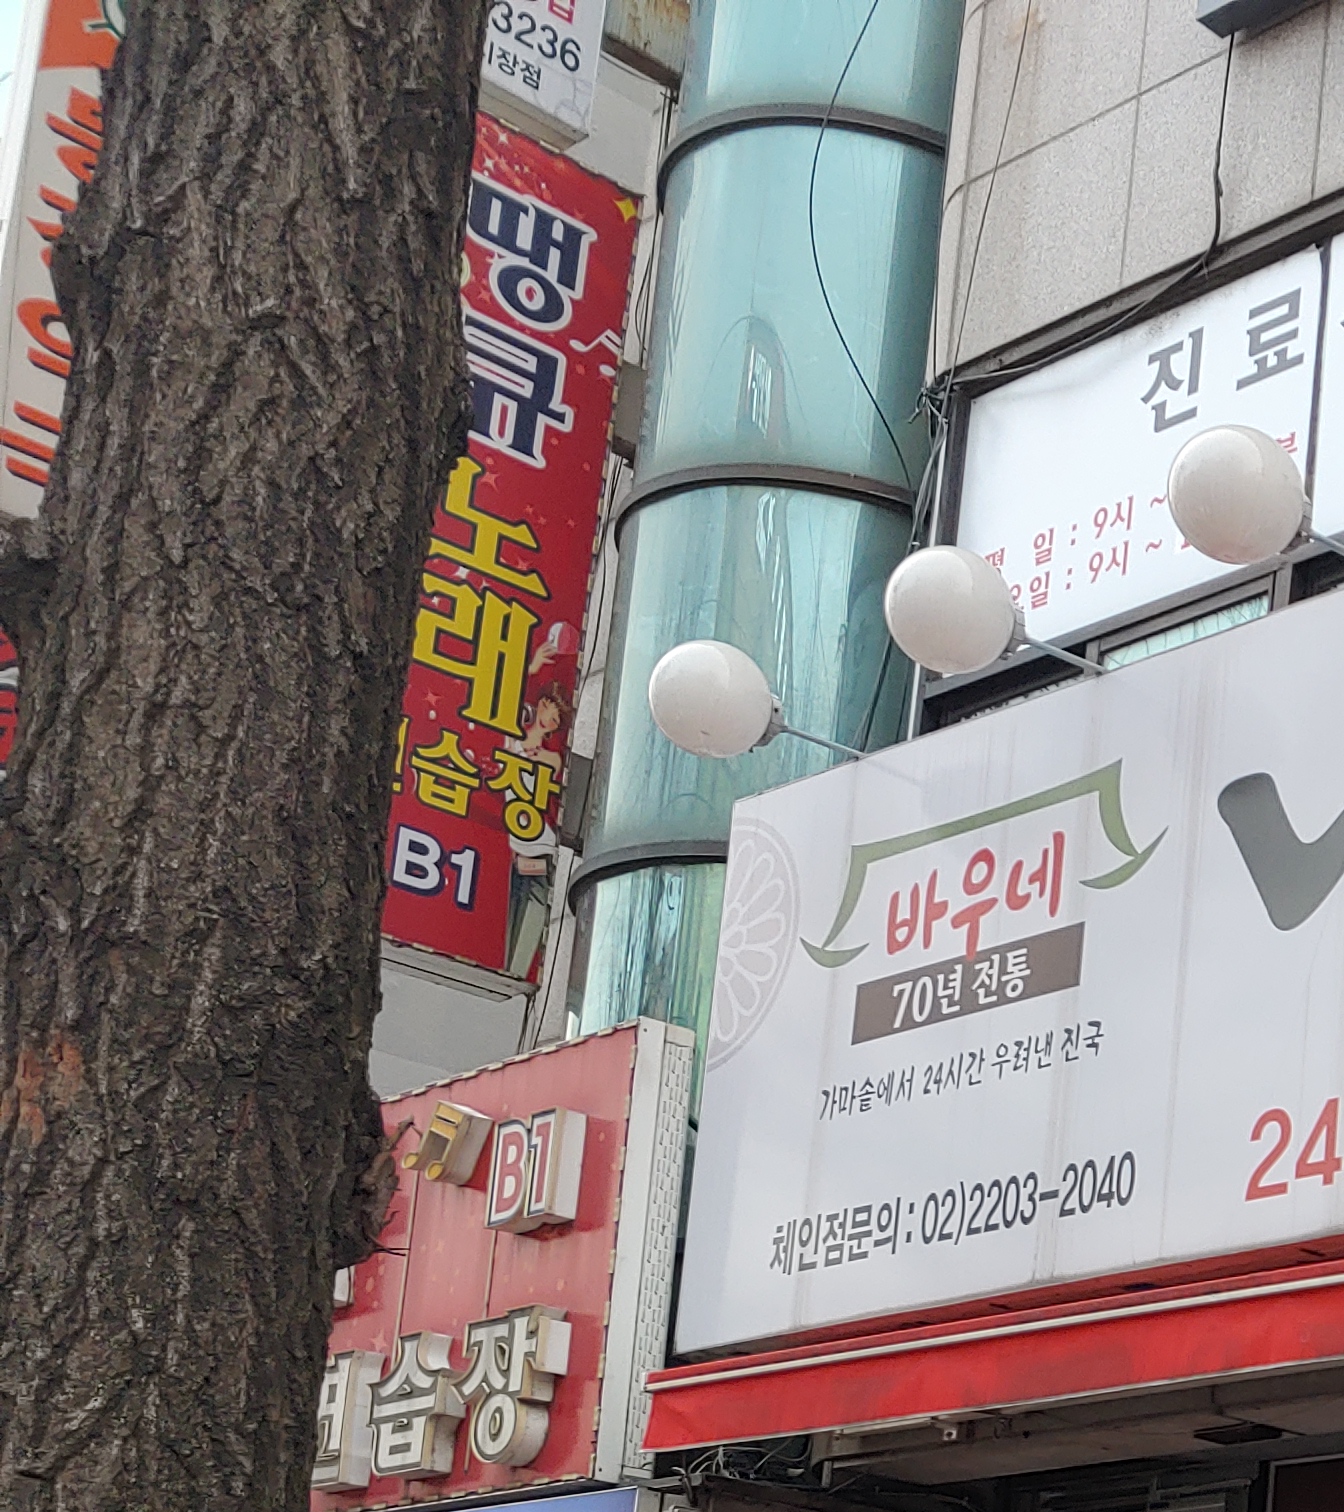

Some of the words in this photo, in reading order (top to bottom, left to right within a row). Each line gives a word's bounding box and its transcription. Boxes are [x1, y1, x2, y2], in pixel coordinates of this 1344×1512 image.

[482, 44, 543, 91] 장점
[398, 718, 561, 842] 습장
[391, 823, 481, 910] B1
[886, 829, 1067, 961] 바우네
[892, 969, 962, 1030] 70년
[970, 945, 1032, 1009] 전통
[818, 1064, 915, 1122] 가마솥에서
[921, 1048, 987, 1097] 24시간
[990, 1030, 1055, 1083] 우려낸
[1060, 1018, 1105, 1065] 진국
